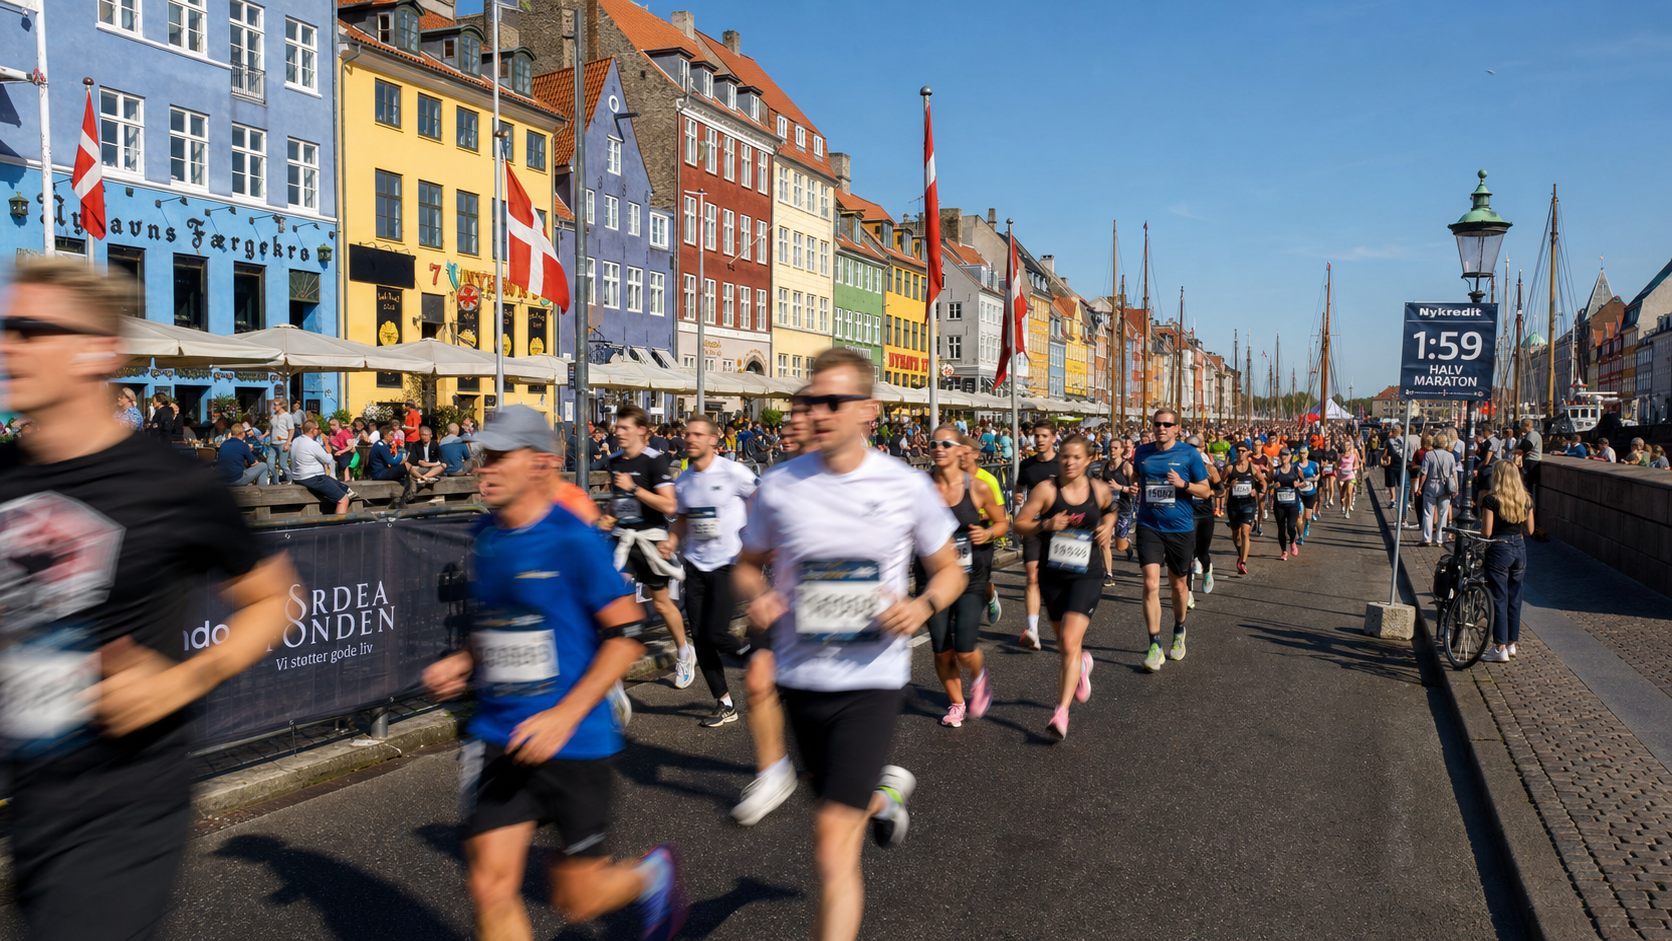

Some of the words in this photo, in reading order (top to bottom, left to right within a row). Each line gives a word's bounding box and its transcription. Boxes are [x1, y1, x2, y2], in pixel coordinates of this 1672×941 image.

[37, 192, 177, 243] Nyavns
[429, 262, 441, 286] 7
[1419, 307, 1482, 318] Nykredit
[1413, 331, 1483, 360] 1:59
[1414, 375, 1478, 387] MARATON
[1429, 364, 1463, 375] HALV
[266, 605, 395, 651] ONDEN
[276, 658, 288, 671] Vi
[290, 652, 328, 669] støtter
[330, 644, 357, 664] gode
[359, 643, 373, 655] liv
